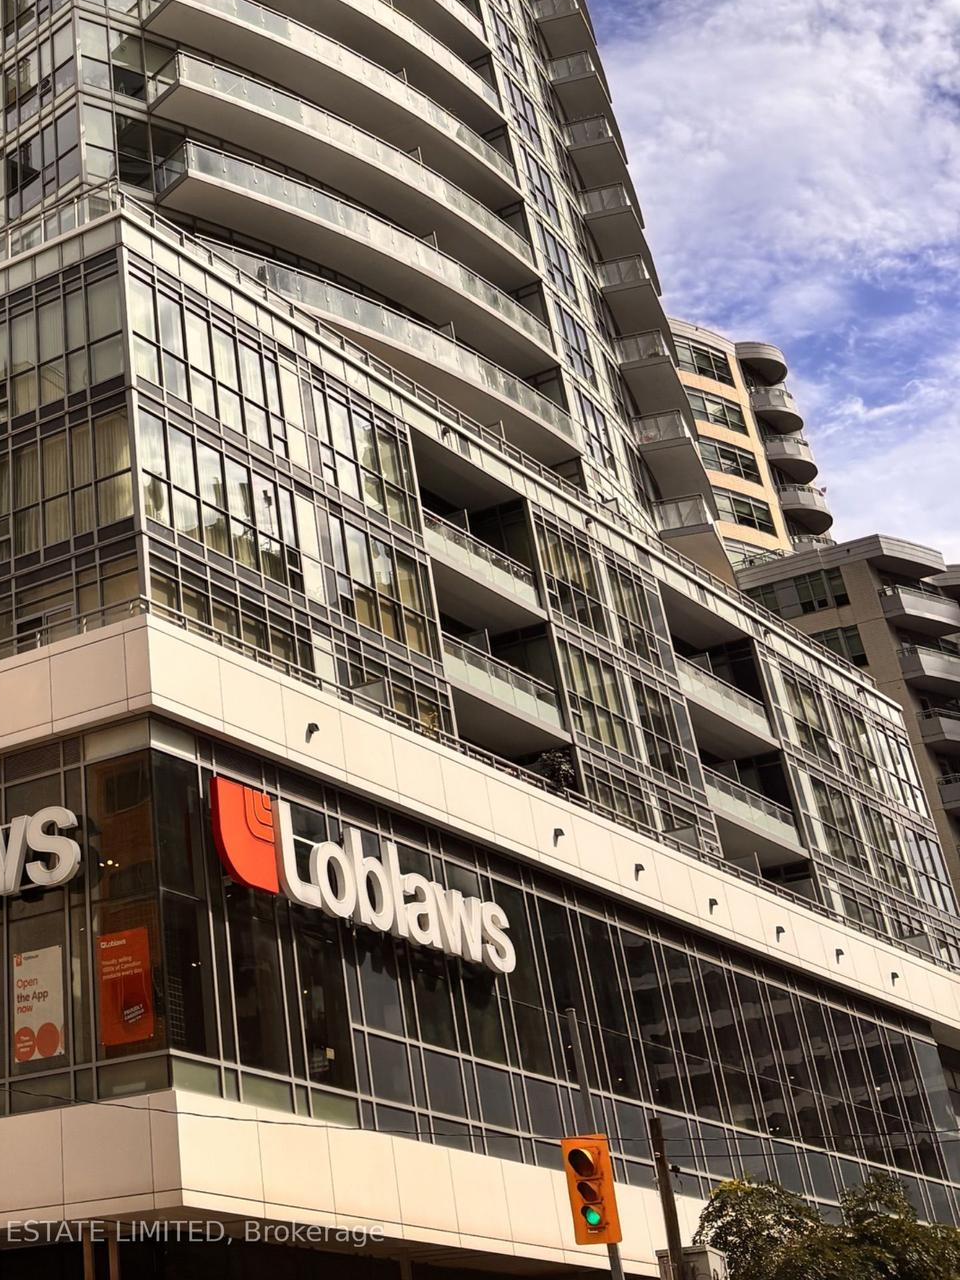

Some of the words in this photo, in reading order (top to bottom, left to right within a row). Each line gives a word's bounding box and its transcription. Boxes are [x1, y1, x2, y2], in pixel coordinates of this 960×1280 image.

[272, 799, 516, 973] Loblaws
[16, 978, 38, 989] Open
[17, 994, 30, 1003] the
[32, 990, 49, 1001] App
[17, 1004, 33, 1014] now
